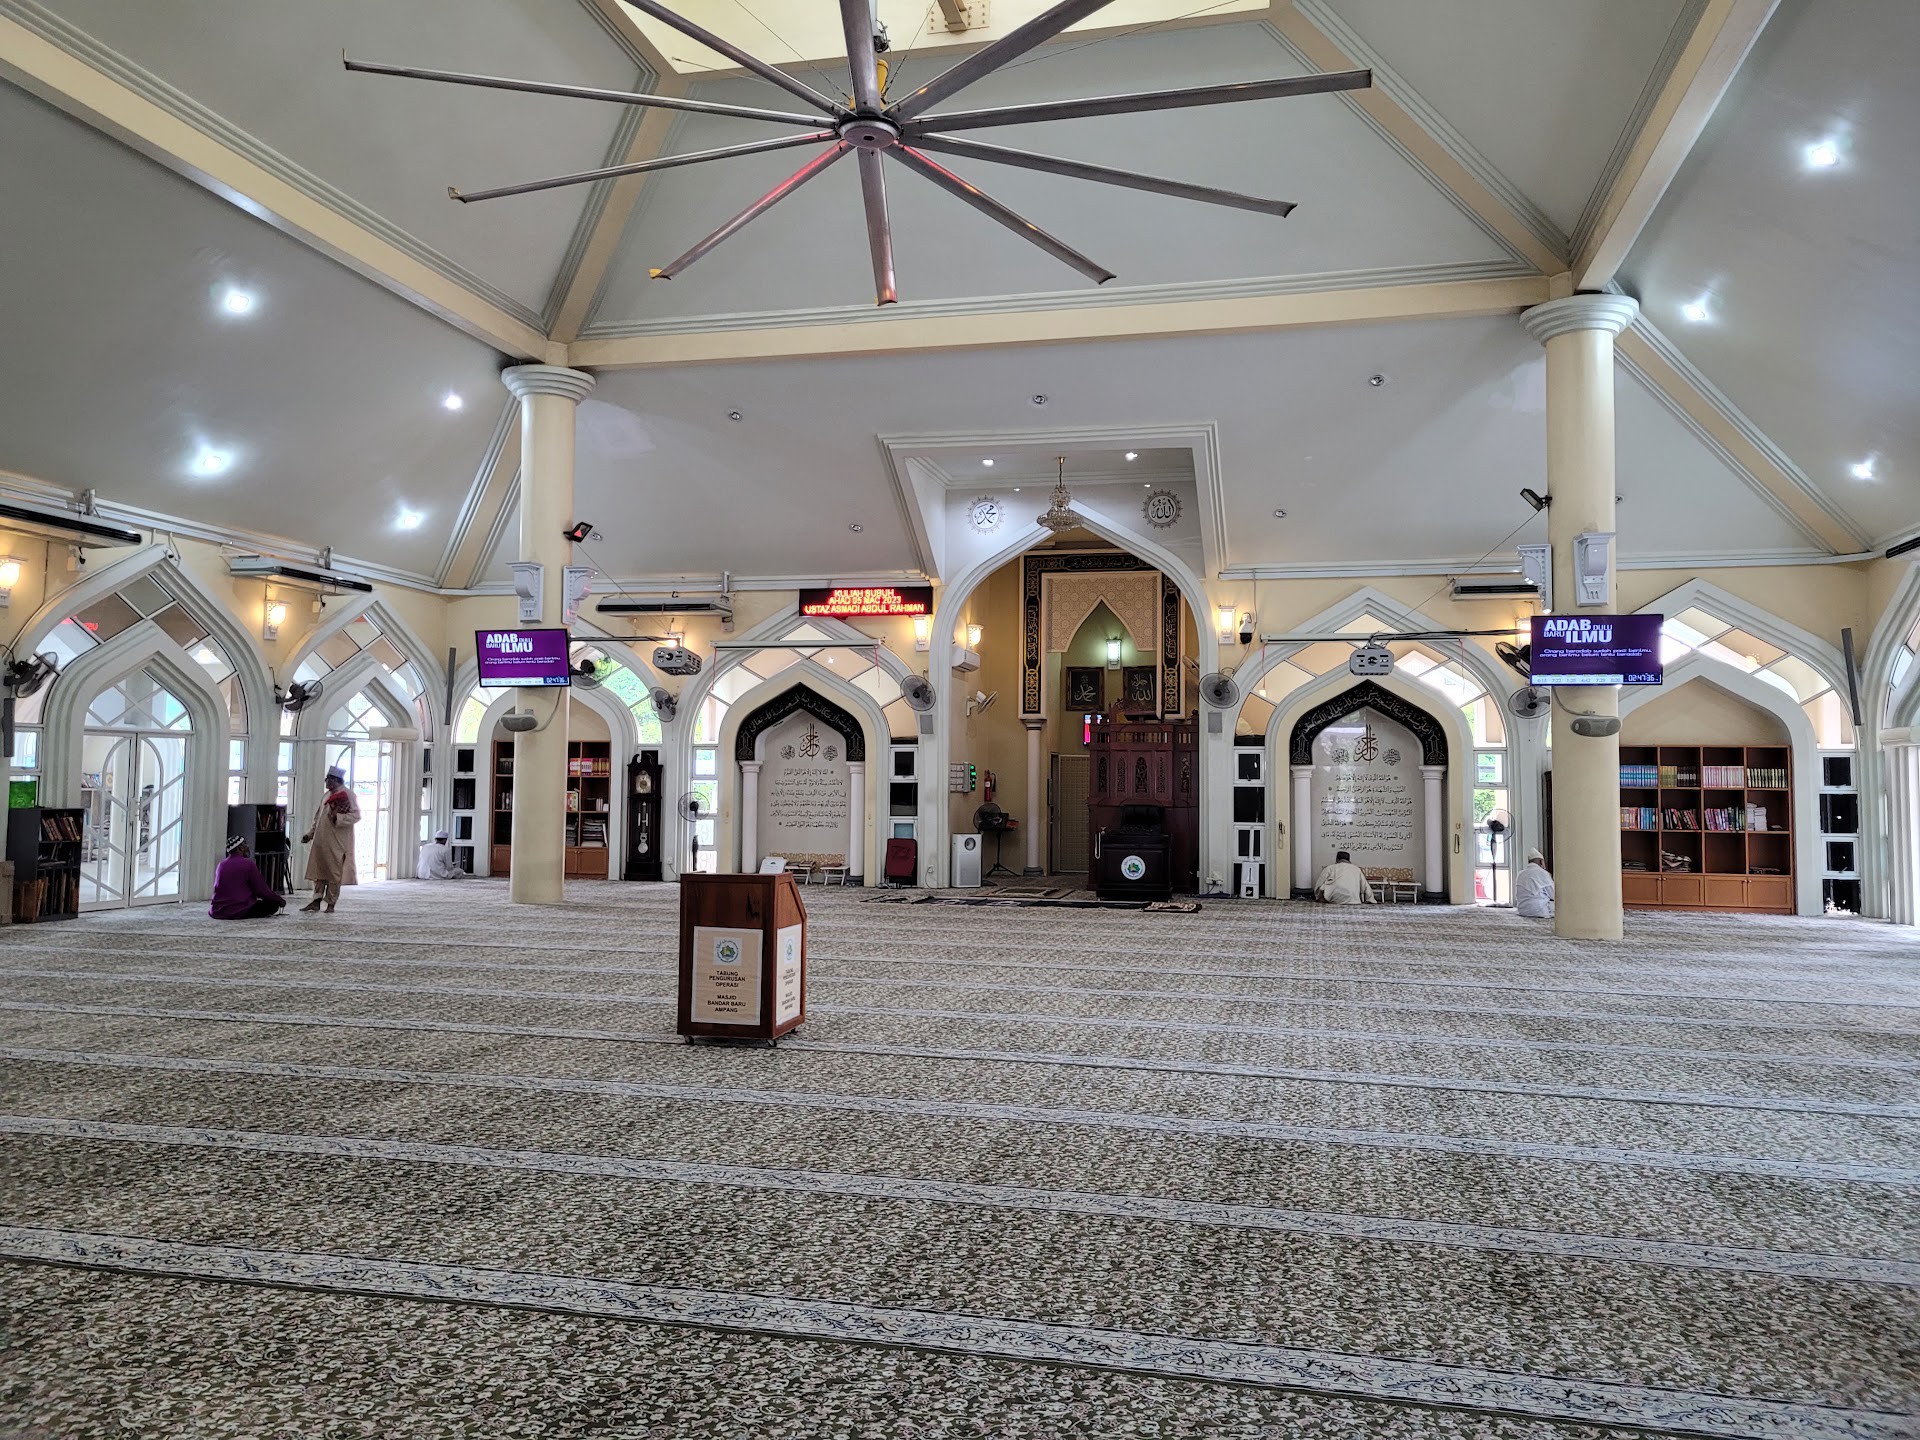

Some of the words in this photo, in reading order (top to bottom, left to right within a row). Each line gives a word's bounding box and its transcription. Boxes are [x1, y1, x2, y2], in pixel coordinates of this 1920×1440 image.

[882, 596, 901, 604] 2023
[805, 605, 830, 613] USTAZ
[831, 605, 860, 613] ASMADI
[861, 604, 889, 613] ABDUL
[890, 604, 924, 612] RAHMAN
[1544, 619, 1592, 631] ADAB
[486, 633, 518, 643] ADAB
[1565, 630, 1613, 643] ILMU
[501, 642, 533, 653] ILMU
